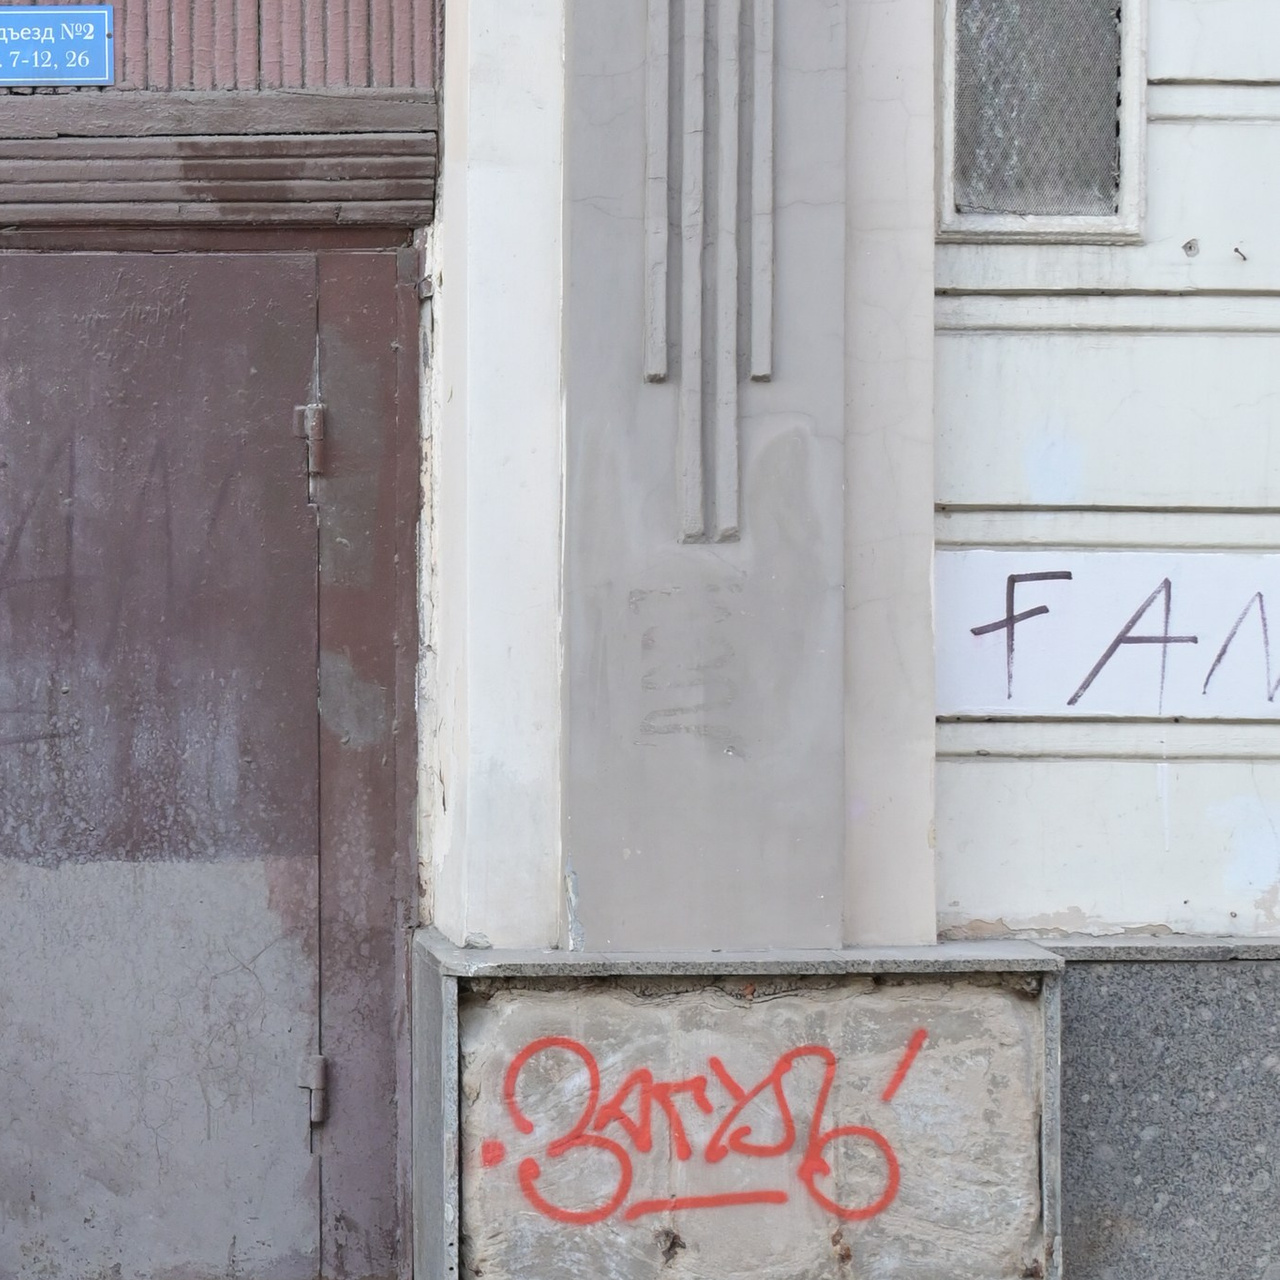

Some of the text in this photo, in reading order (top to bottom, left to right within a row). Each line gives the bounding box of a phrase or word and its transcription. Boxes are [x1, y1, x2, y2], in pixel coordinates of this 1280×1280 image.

[60, 23, 95, 40] №2
[9, 50, 58, 70] 7-12,
[65, 50, 90, 68] 26
